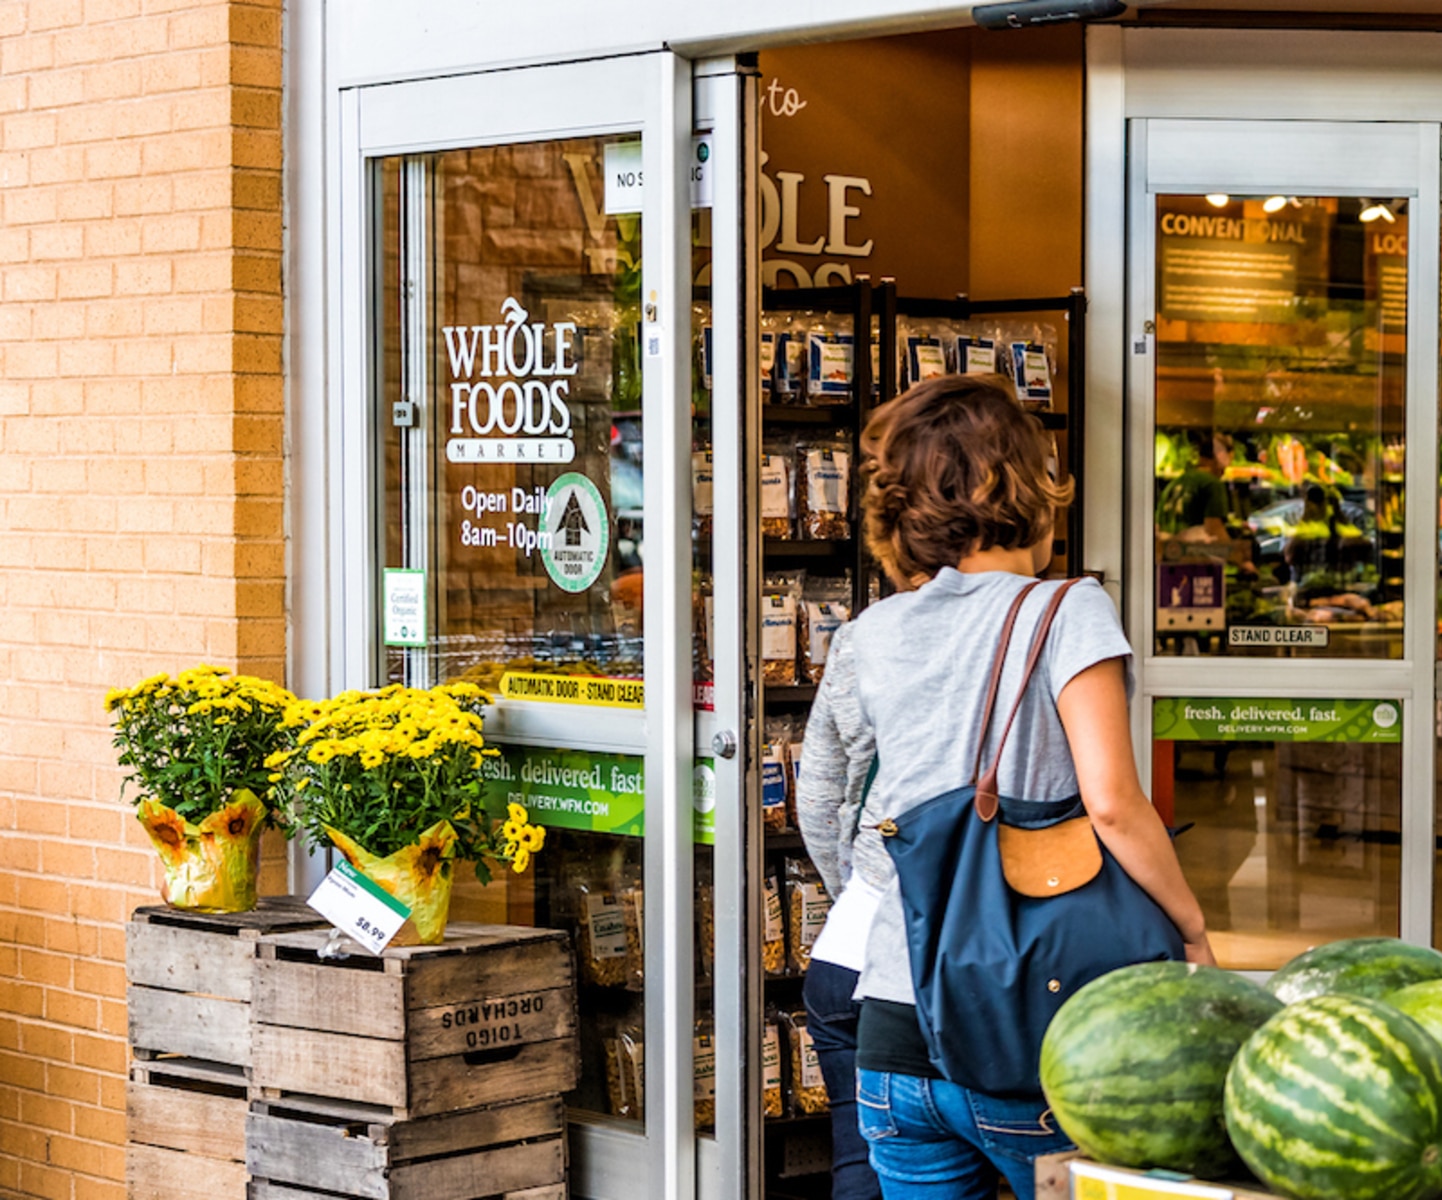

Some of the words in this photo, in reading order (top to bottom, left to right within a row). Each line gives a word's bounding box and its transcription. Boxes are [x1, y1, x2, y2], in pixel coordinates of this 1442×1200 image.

[767, 77, 808, 117] to
[617, 173, 635, 188] NO
[1161, 212, 1306, 244] CONVENTONAL
[442, 297, 578, 379] WHOLE
[450, 380, 570, 435] FOODS
[456, 442, 565, 458] MARKET
[461, 485, 507, 519] Open
[511, 486, 554, 522] Daily
[554, 551, 594, 562] AUTOMATIC
[564, 563, 583, 575] DOOR
[1232, 629, 1271, 643] STAND
[1275, 630, 1313, 643] CLEAR
[508, 678, 554, 697] AUTOMATIC
[556, 680, 579, 699] DOOR
[587, 684, 615, 701] STAND
[1184, 705, 1226, 720] fresh.
[1230, 706, 1305, 722] delivered.
[1309, 707, 1341, 722] fast.
[521, 758, 606, 791] delivered.
[338, 861, 357, 879] New
[355, 916, 386, 941] $8.99
[442, 996, 544, 1029] ORCHARDS
[466, 1023, 523, 1048] TOIGO
